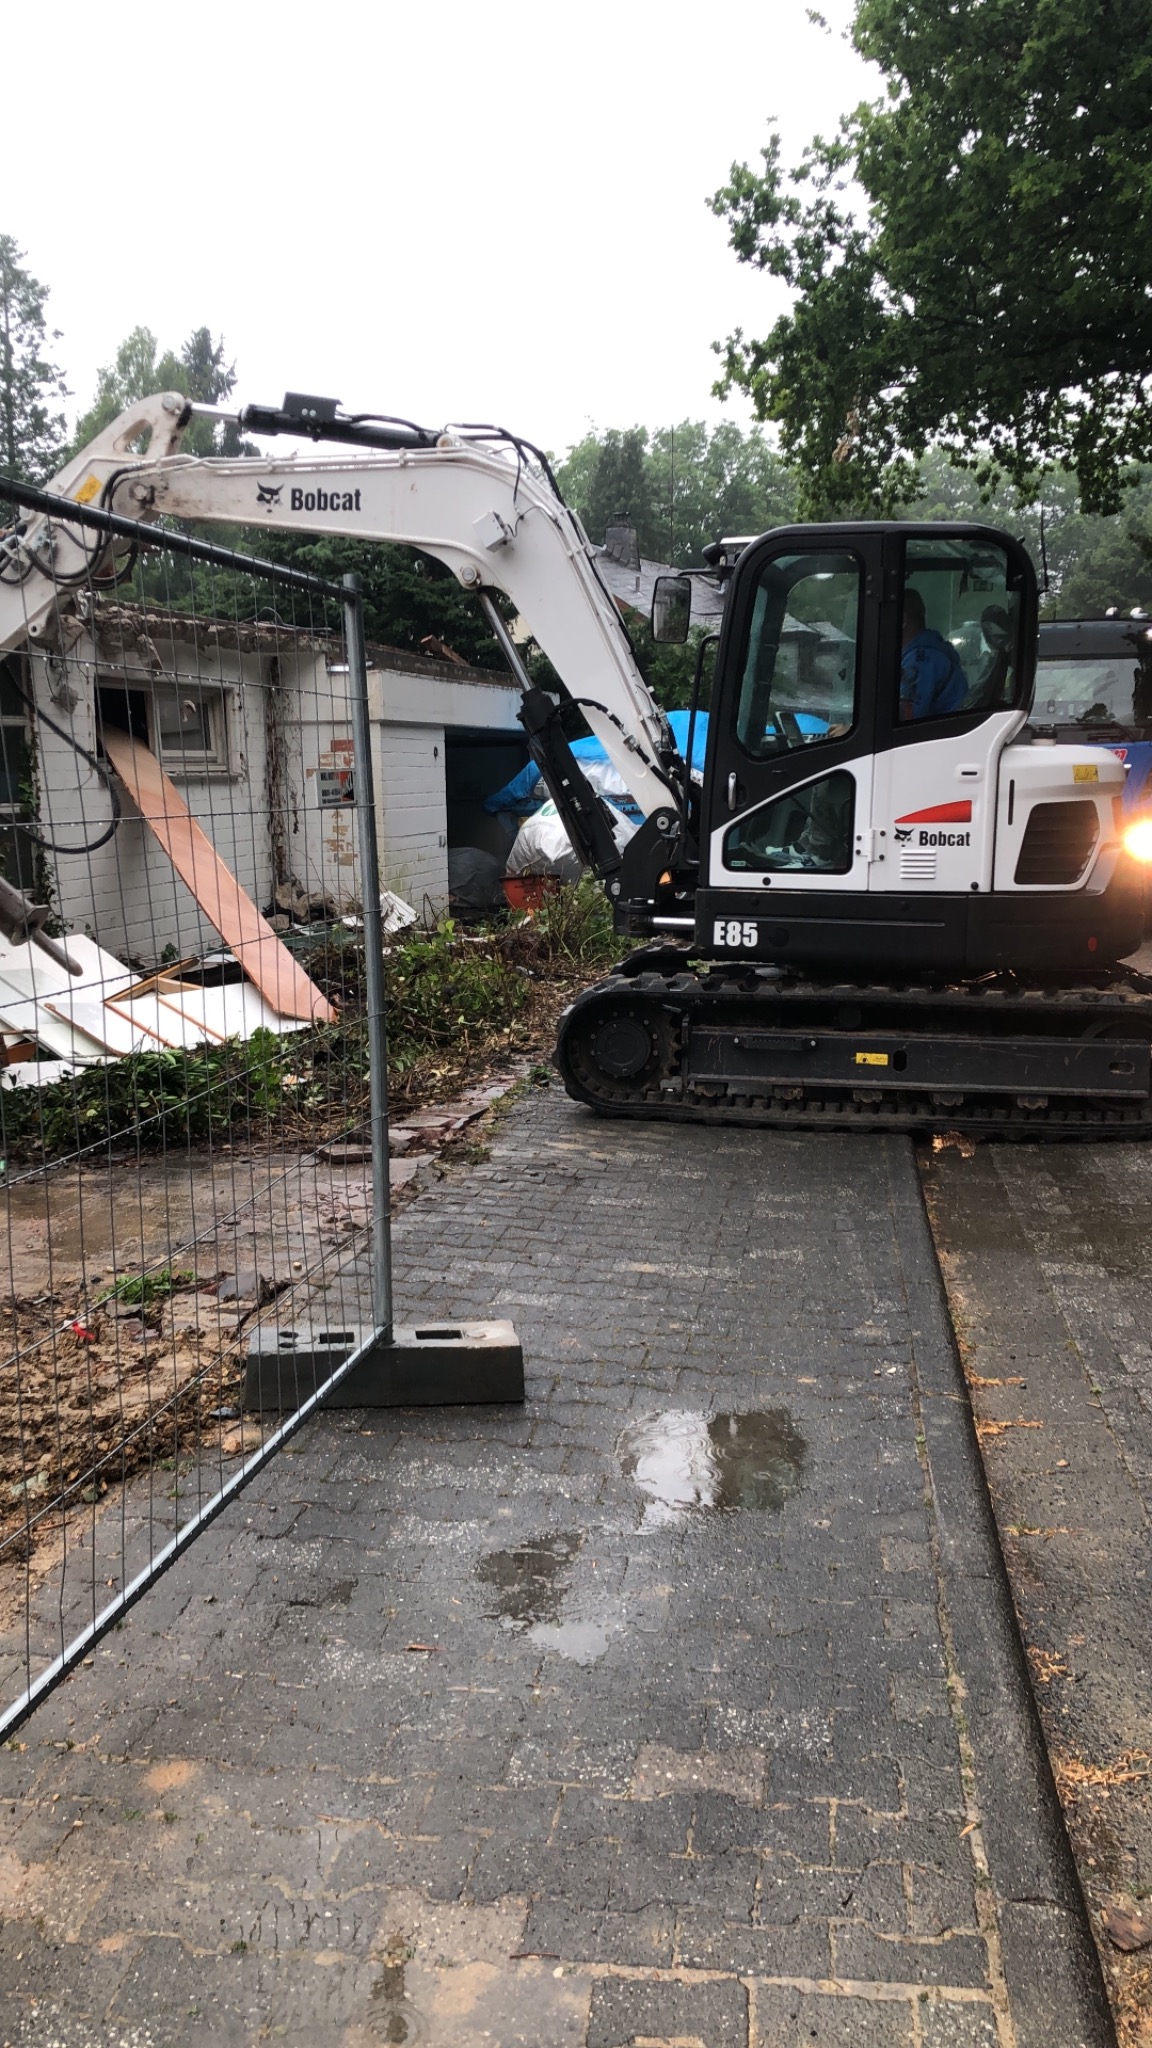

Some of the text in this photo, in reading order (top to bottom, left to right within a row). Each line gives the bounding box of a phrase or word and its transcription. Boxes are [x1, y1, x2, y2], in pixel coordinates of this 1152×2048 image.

[291, 487, 362, 512] Bobcat
[919, 830, 971, 847] Bobcat
[713, 920, 758, 947] E85
